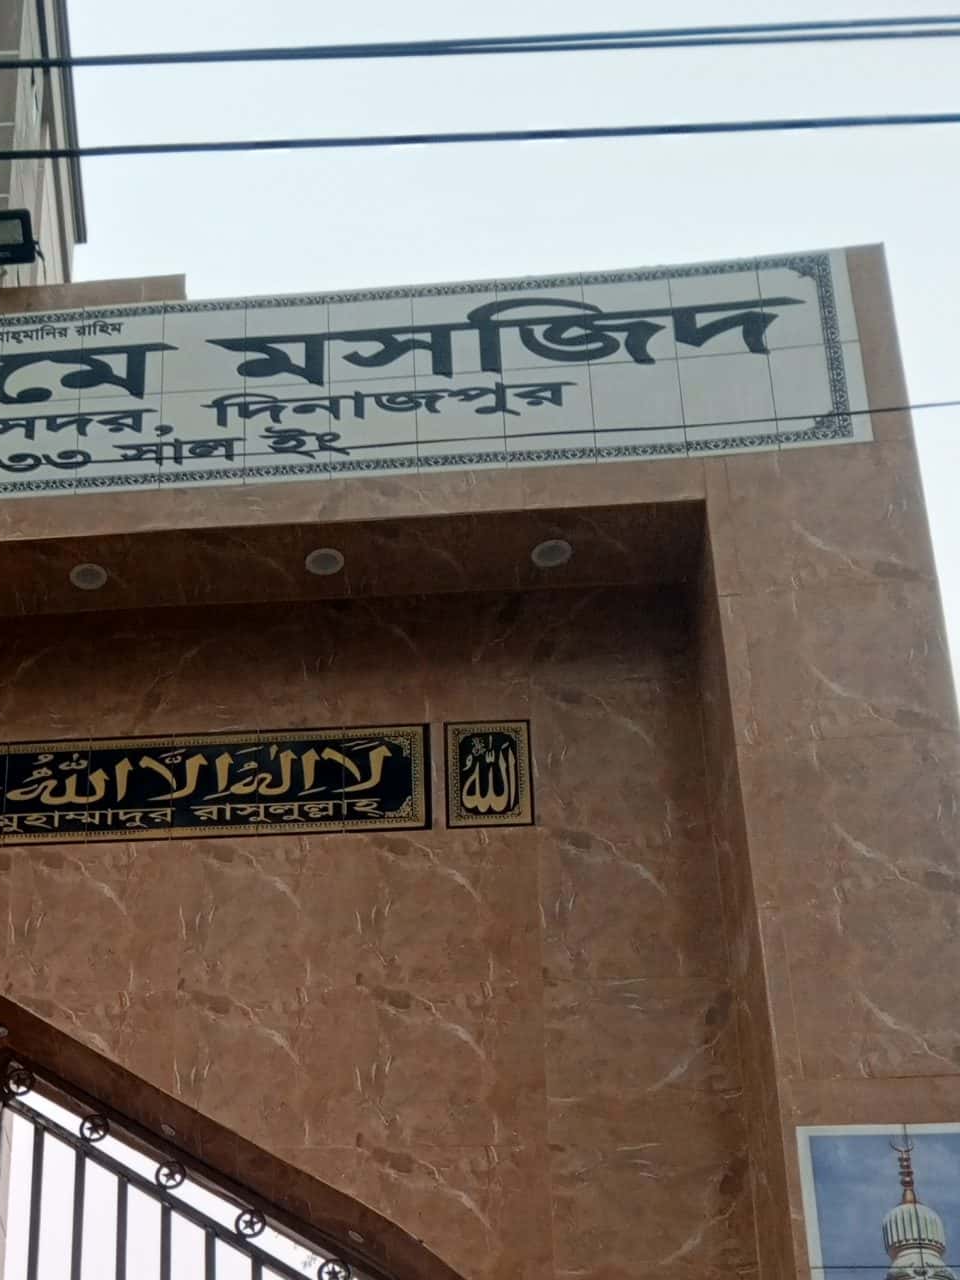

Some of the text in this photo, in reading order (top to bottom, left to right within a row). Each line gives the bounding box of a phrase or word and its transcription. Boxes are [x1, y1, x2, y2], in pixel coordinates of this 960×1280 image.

[72, 320, 123, 337] রাহিম
[205, 296, 807, 387] মসজিদ
[202, 381, 578, 427] দিনাজপুর
[112, 438, 247, 467] সাল
[258, 426, 351, 460] ইং
